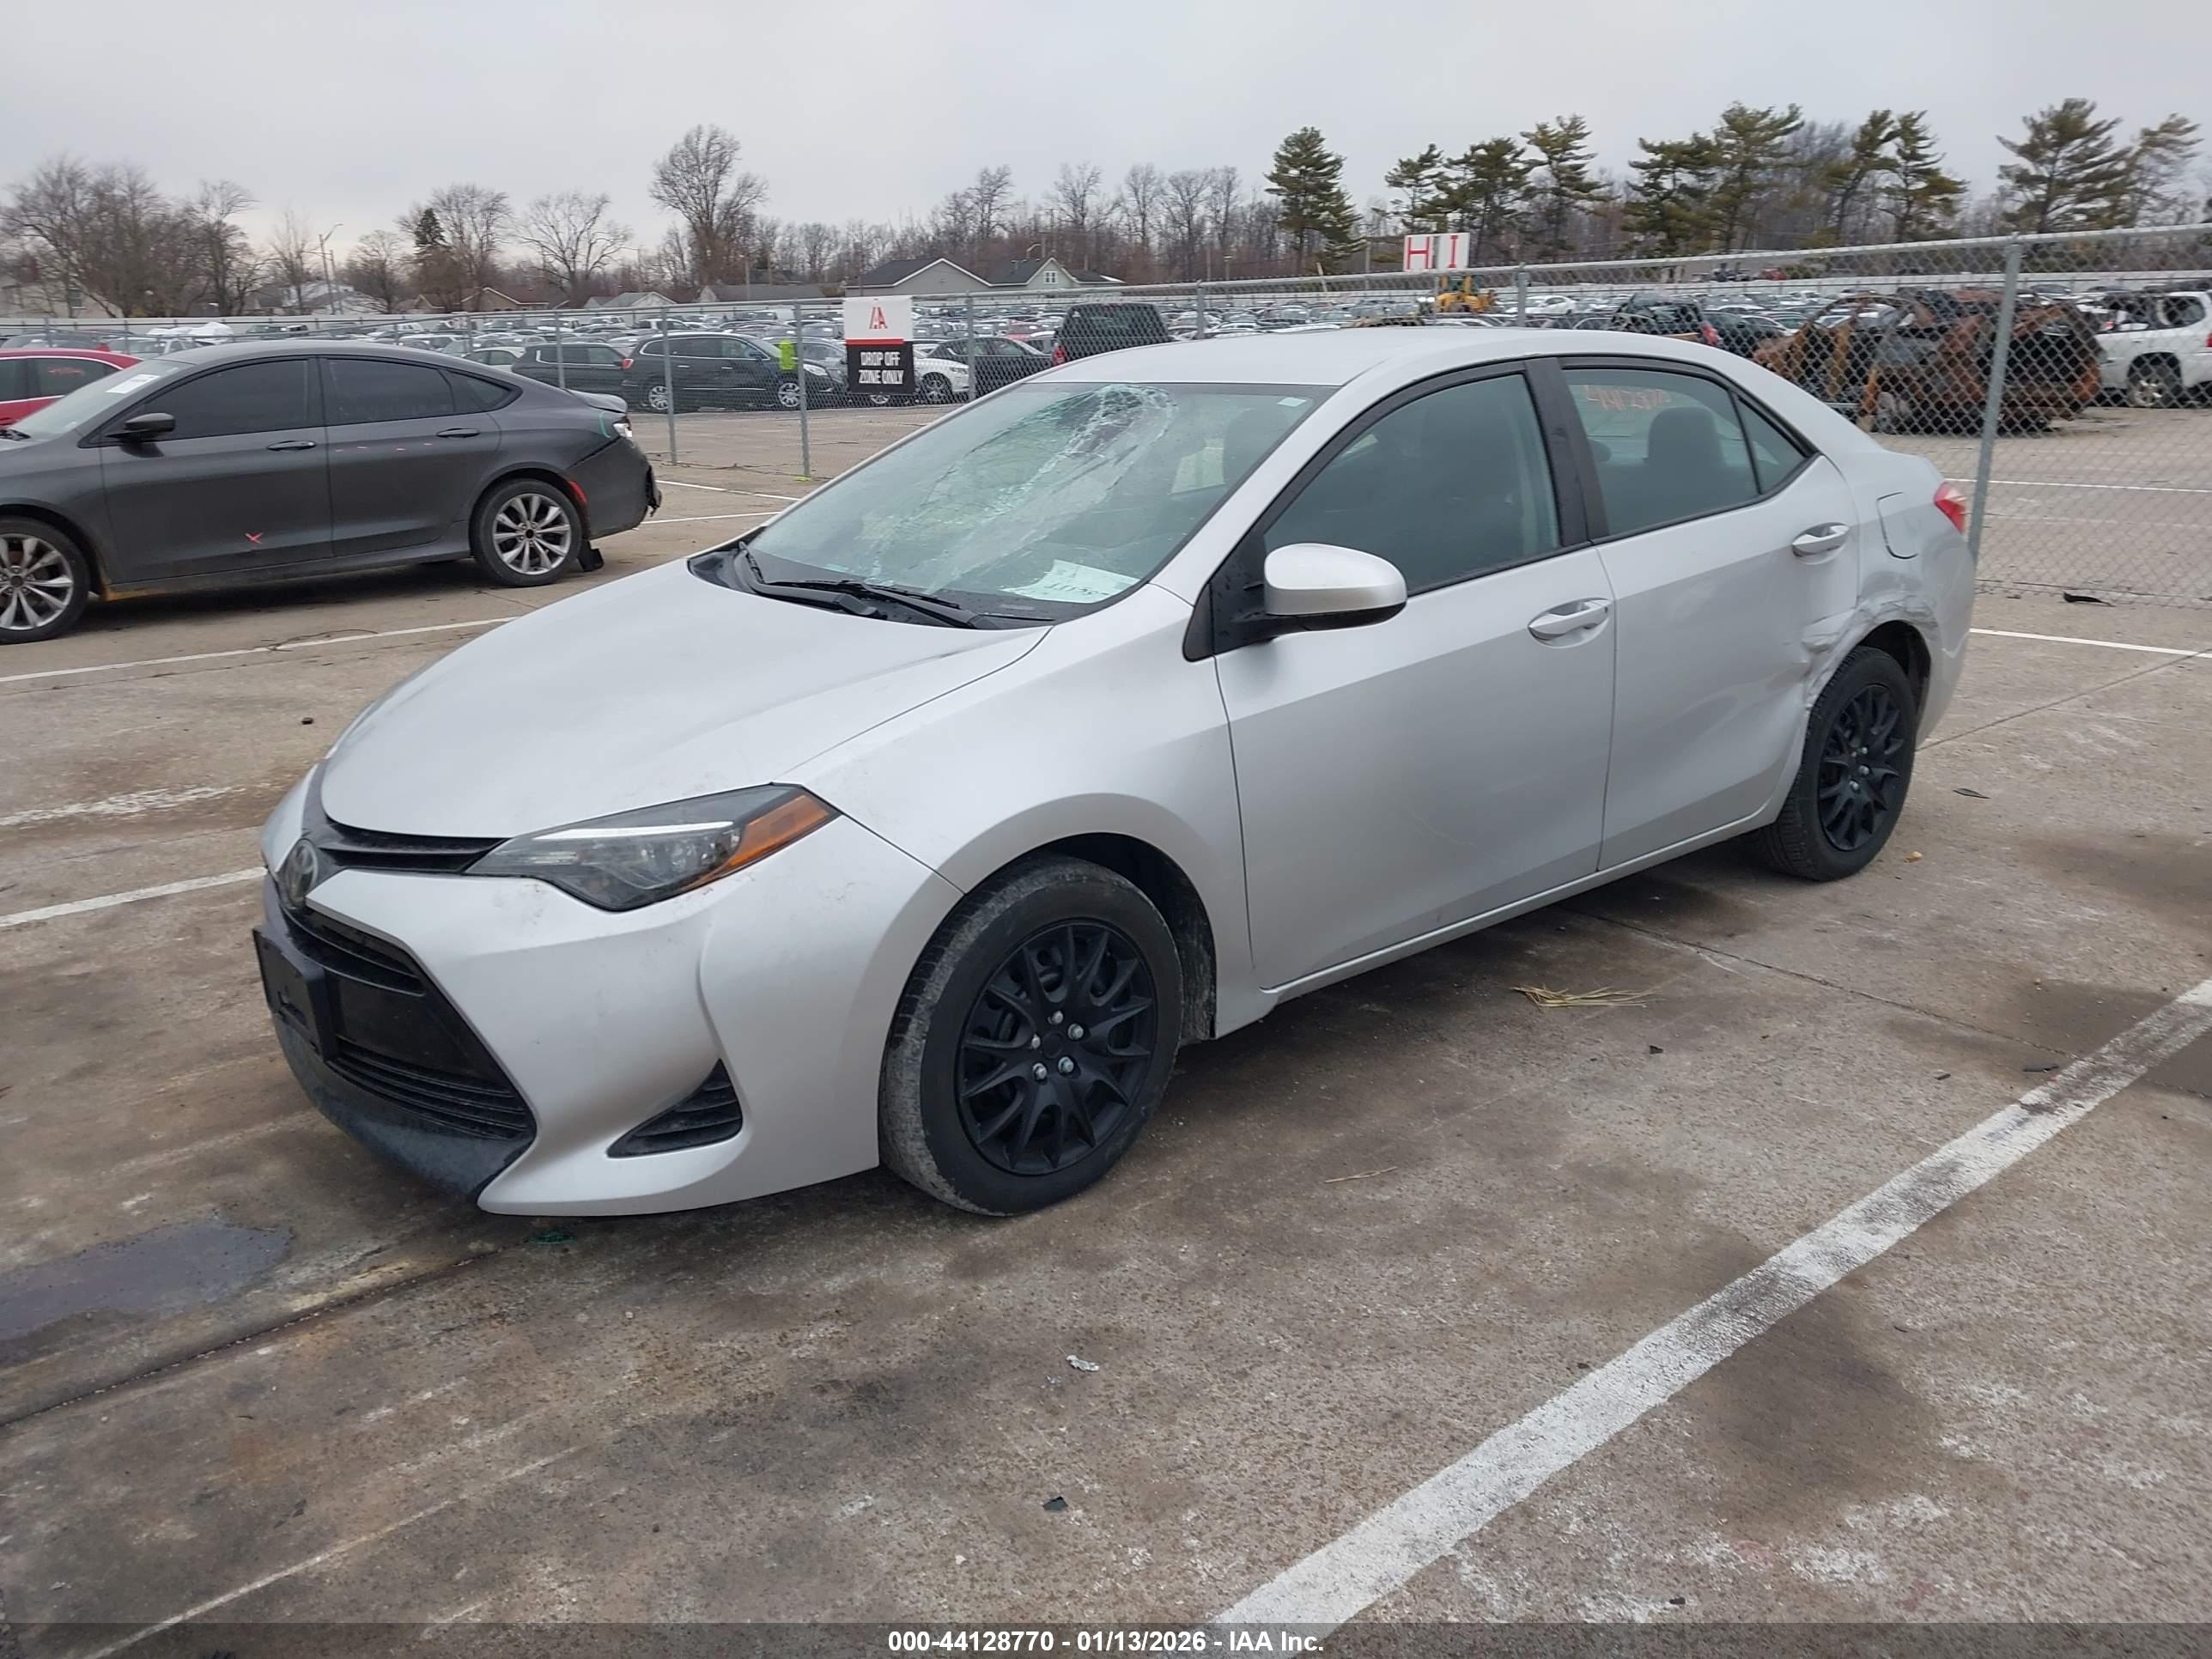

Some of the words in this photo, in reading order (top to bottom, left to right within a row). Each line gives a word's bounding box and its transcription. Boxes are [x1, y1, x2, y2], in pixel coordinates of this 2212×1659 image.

[860, 351, 884, 366] DROP
[884, 351, 901, 366] OFF
[858, 369, 881, 384] ZONE
[882, 369, 904, 385] ONLY
